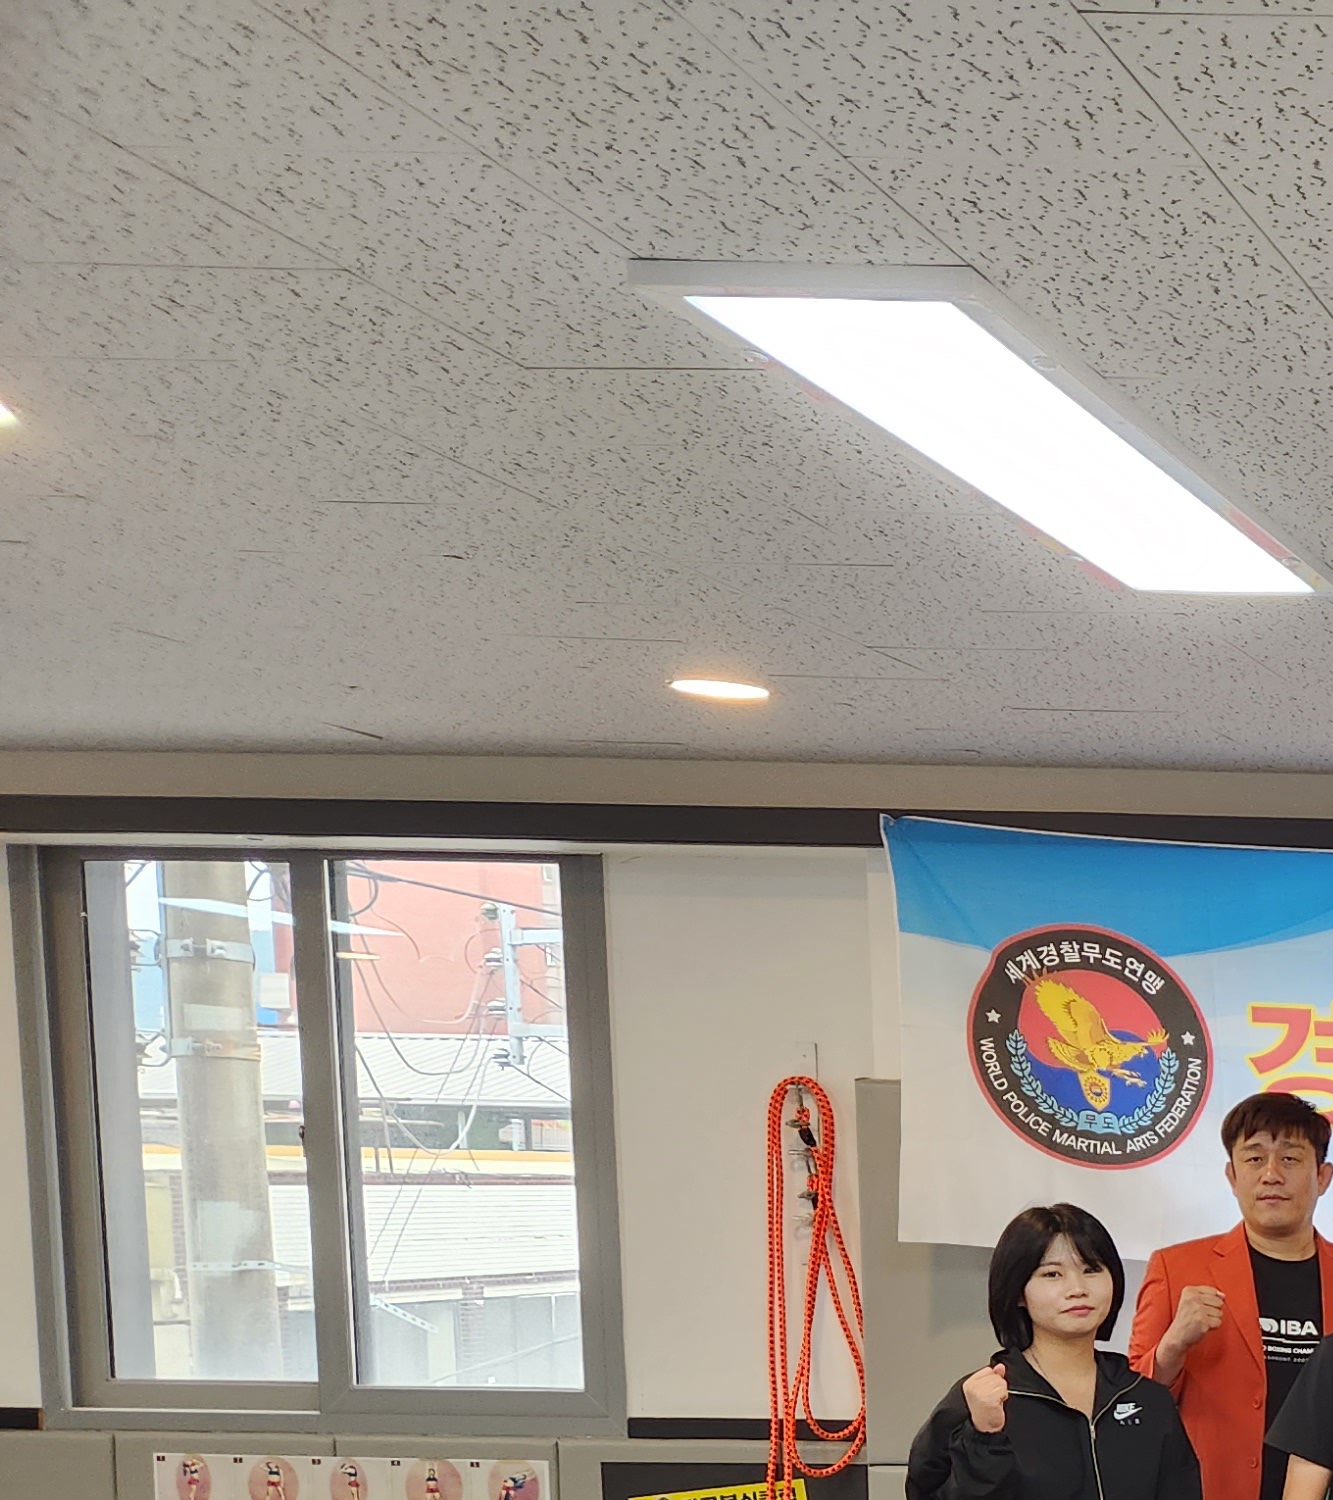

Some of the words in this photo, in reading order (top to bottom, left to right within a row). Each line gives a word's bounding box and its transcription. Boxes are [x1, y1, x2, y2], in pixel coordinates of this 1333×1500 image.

[1004, 940, 1165, 995] 세계경찰무도연맹
[979, 1037, 1008, 1091] WORLD
[1002, 1090, 1052, 1136] POLICE
[1052, 1128, 1122, 1155] MARTIAL
[1126, 1130, 1159, 1153] ARTS
[1155, 1057, 1202, 1137] FEDERATION
[1083, 1115, 1117, 1130] 무도
[1280, 1319, 1318, 1336] IBA
